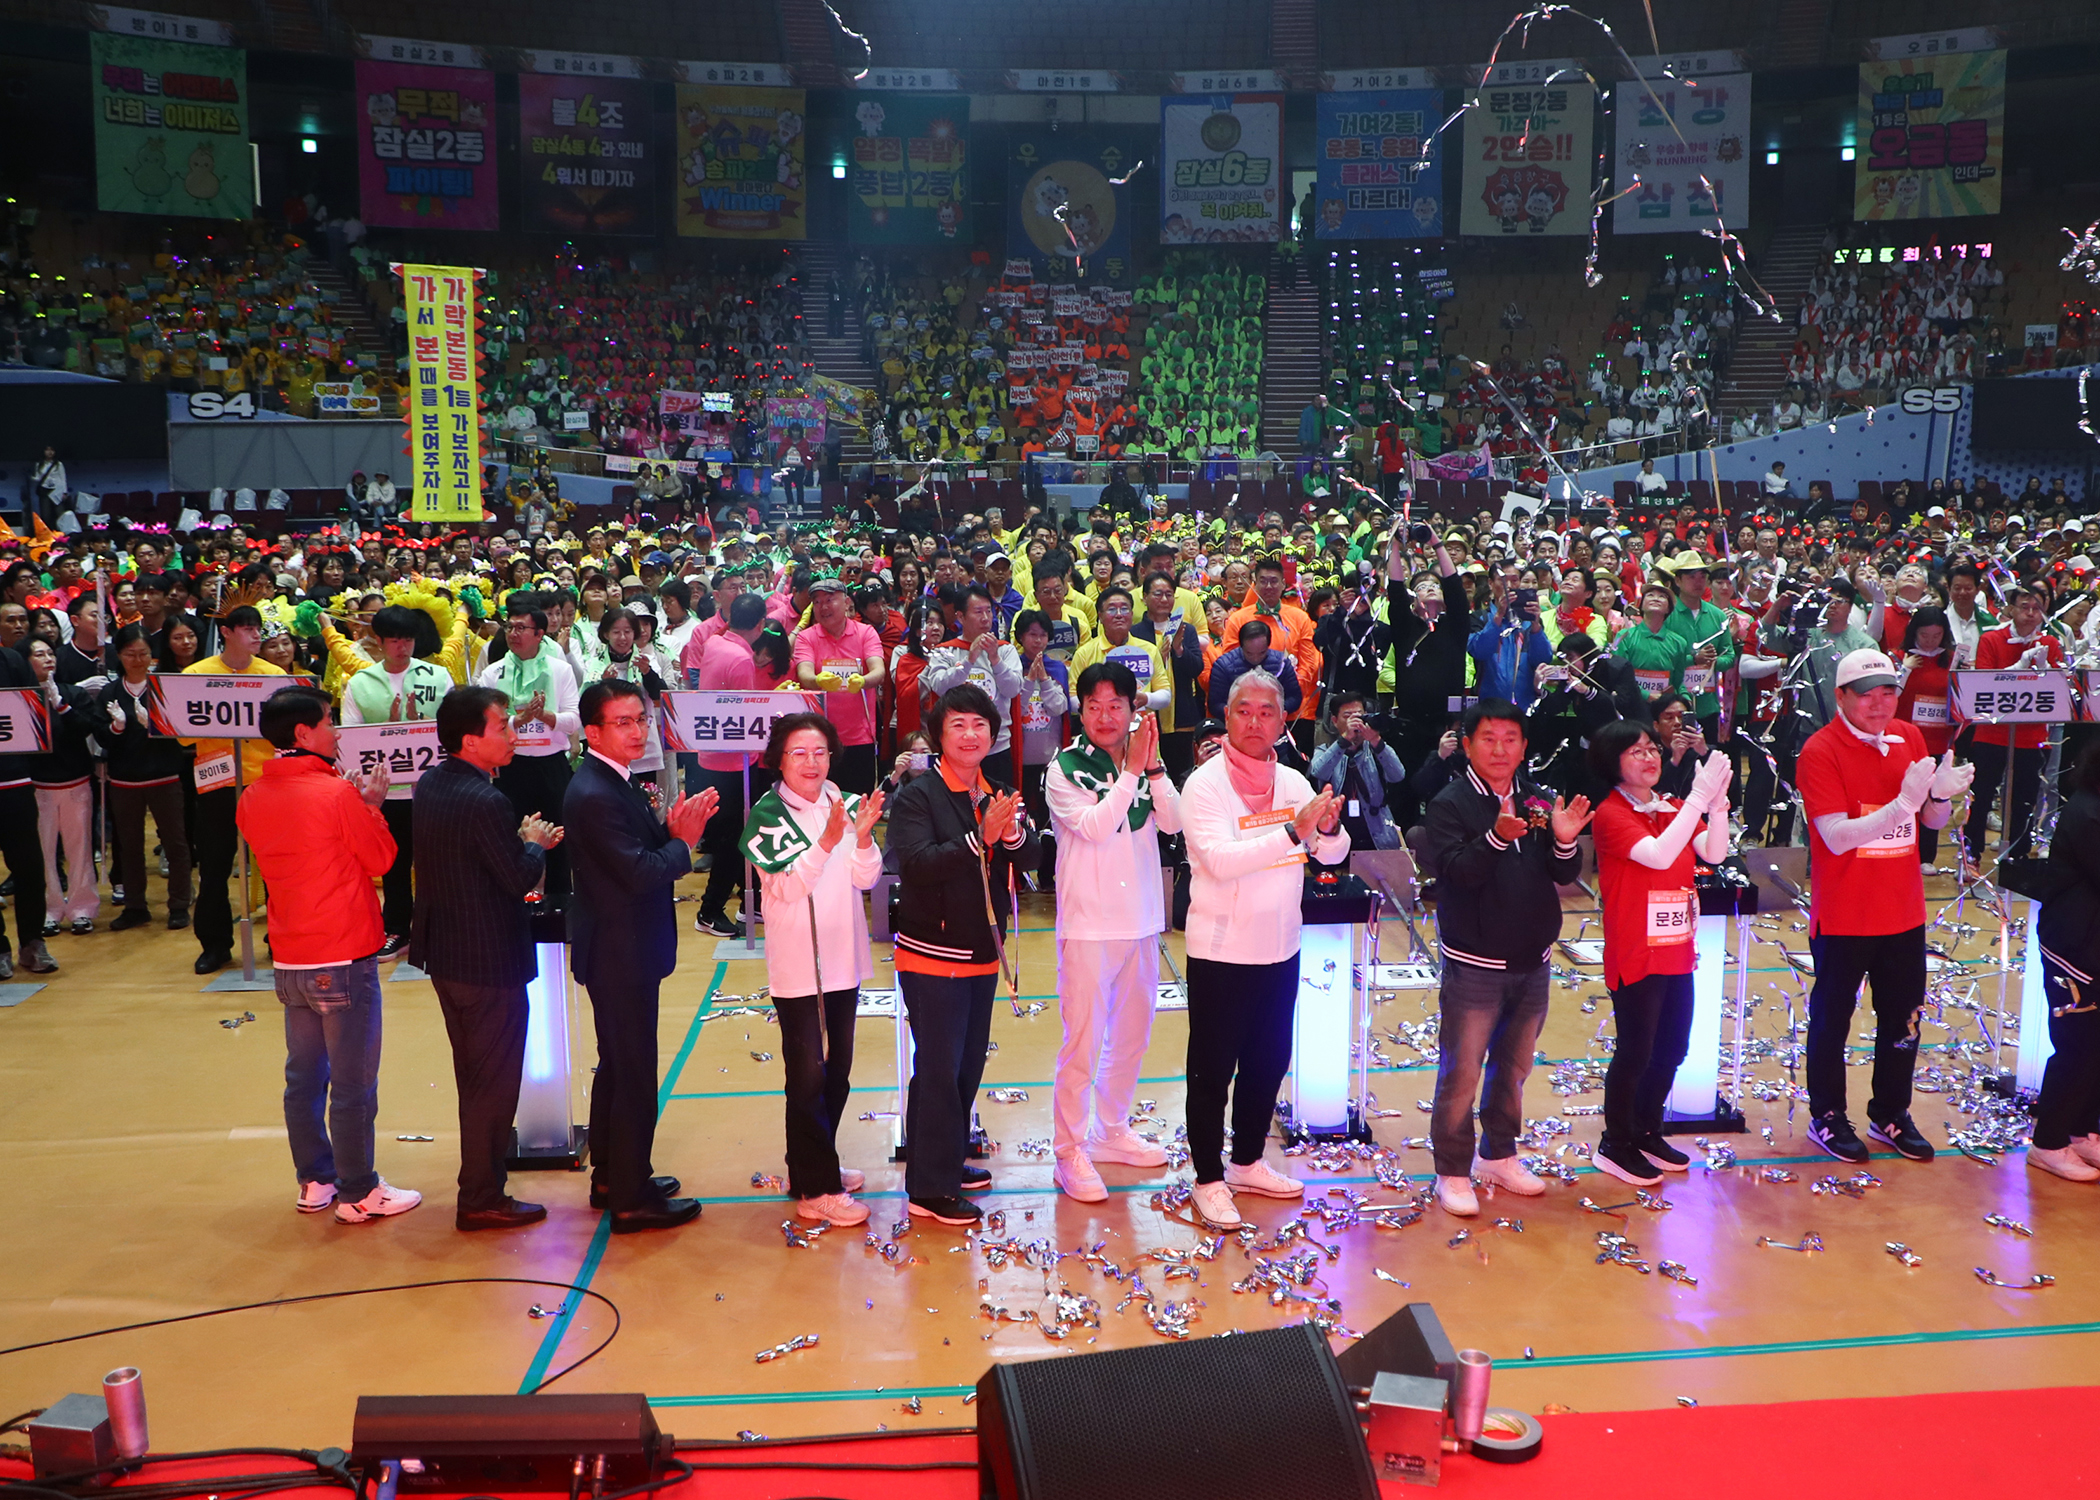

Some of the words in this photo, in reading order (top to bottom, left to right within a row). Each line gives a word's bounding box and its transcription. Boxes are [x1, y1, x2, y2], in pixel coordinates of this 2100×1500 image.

[104, 97, 162, 127] 너희는
[396, 88, 459, 124] 무적
[1490, 90, 1567, 113] 문정2동
[1336, 111, 1424, 136] 거여2동!
[373, 125, 484, 163] 잠실2동
[532, 134, 586, 155] 잠실4동
[1482, 134, 1573, 162] 2연승!!
[1868, 119, 1988, 171] 오금동
[1175, 151, 1270, 187] 잠실6동
[1656, 155, 1708, 166] RUNNING
[591, 170, 636, 187] 이기자
[699, 186, 786, 211] Winner
[411, 276, 437, 326] 가서
[443, 277, 468, 382] 가락본동
[414, 336, 440, 407] 본때를
[189, 391, 256, 420] S4
[442, 385, 471, 408] 1등
[1902, 386, 1963, 414] S5
[422, 414, 441, 511] 보여주자!!
[451, 414, 470, 511] 가보자고!!
[187, 700, 264, 726] 방이1
[1974, 691, 2056, 714] 문정2동
[380, 728, 408, 737] 송파구민
[693, 716, 778, 740] 잠실4
[199, 761, 230, 780] 방이1동
[747, 816, 808, 865] 전
